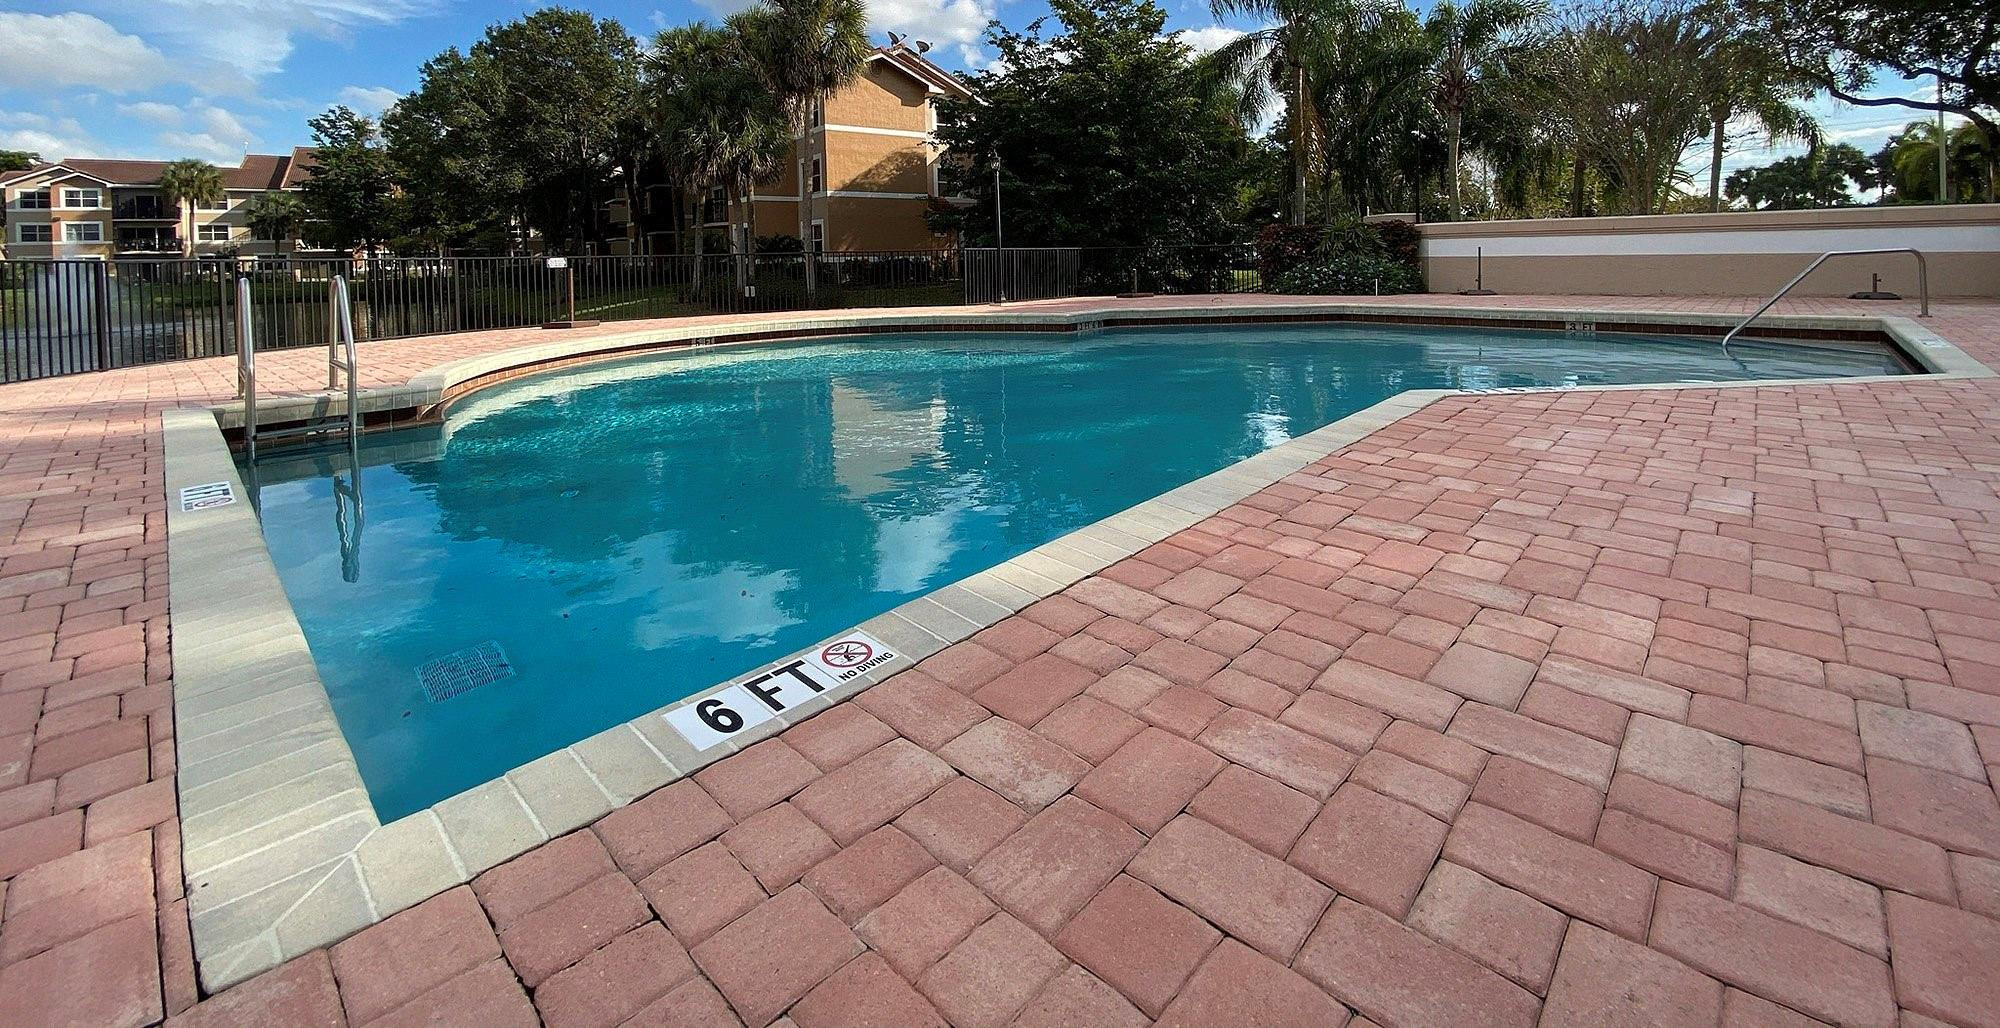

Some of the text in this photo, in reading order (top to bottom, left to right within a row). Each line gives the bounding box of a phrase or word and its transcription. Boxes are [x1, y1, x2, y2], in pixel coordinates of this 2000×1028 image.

[838, 651, 894, 682] NO DIVING
[696, 660, 826, 733] 6 FT
